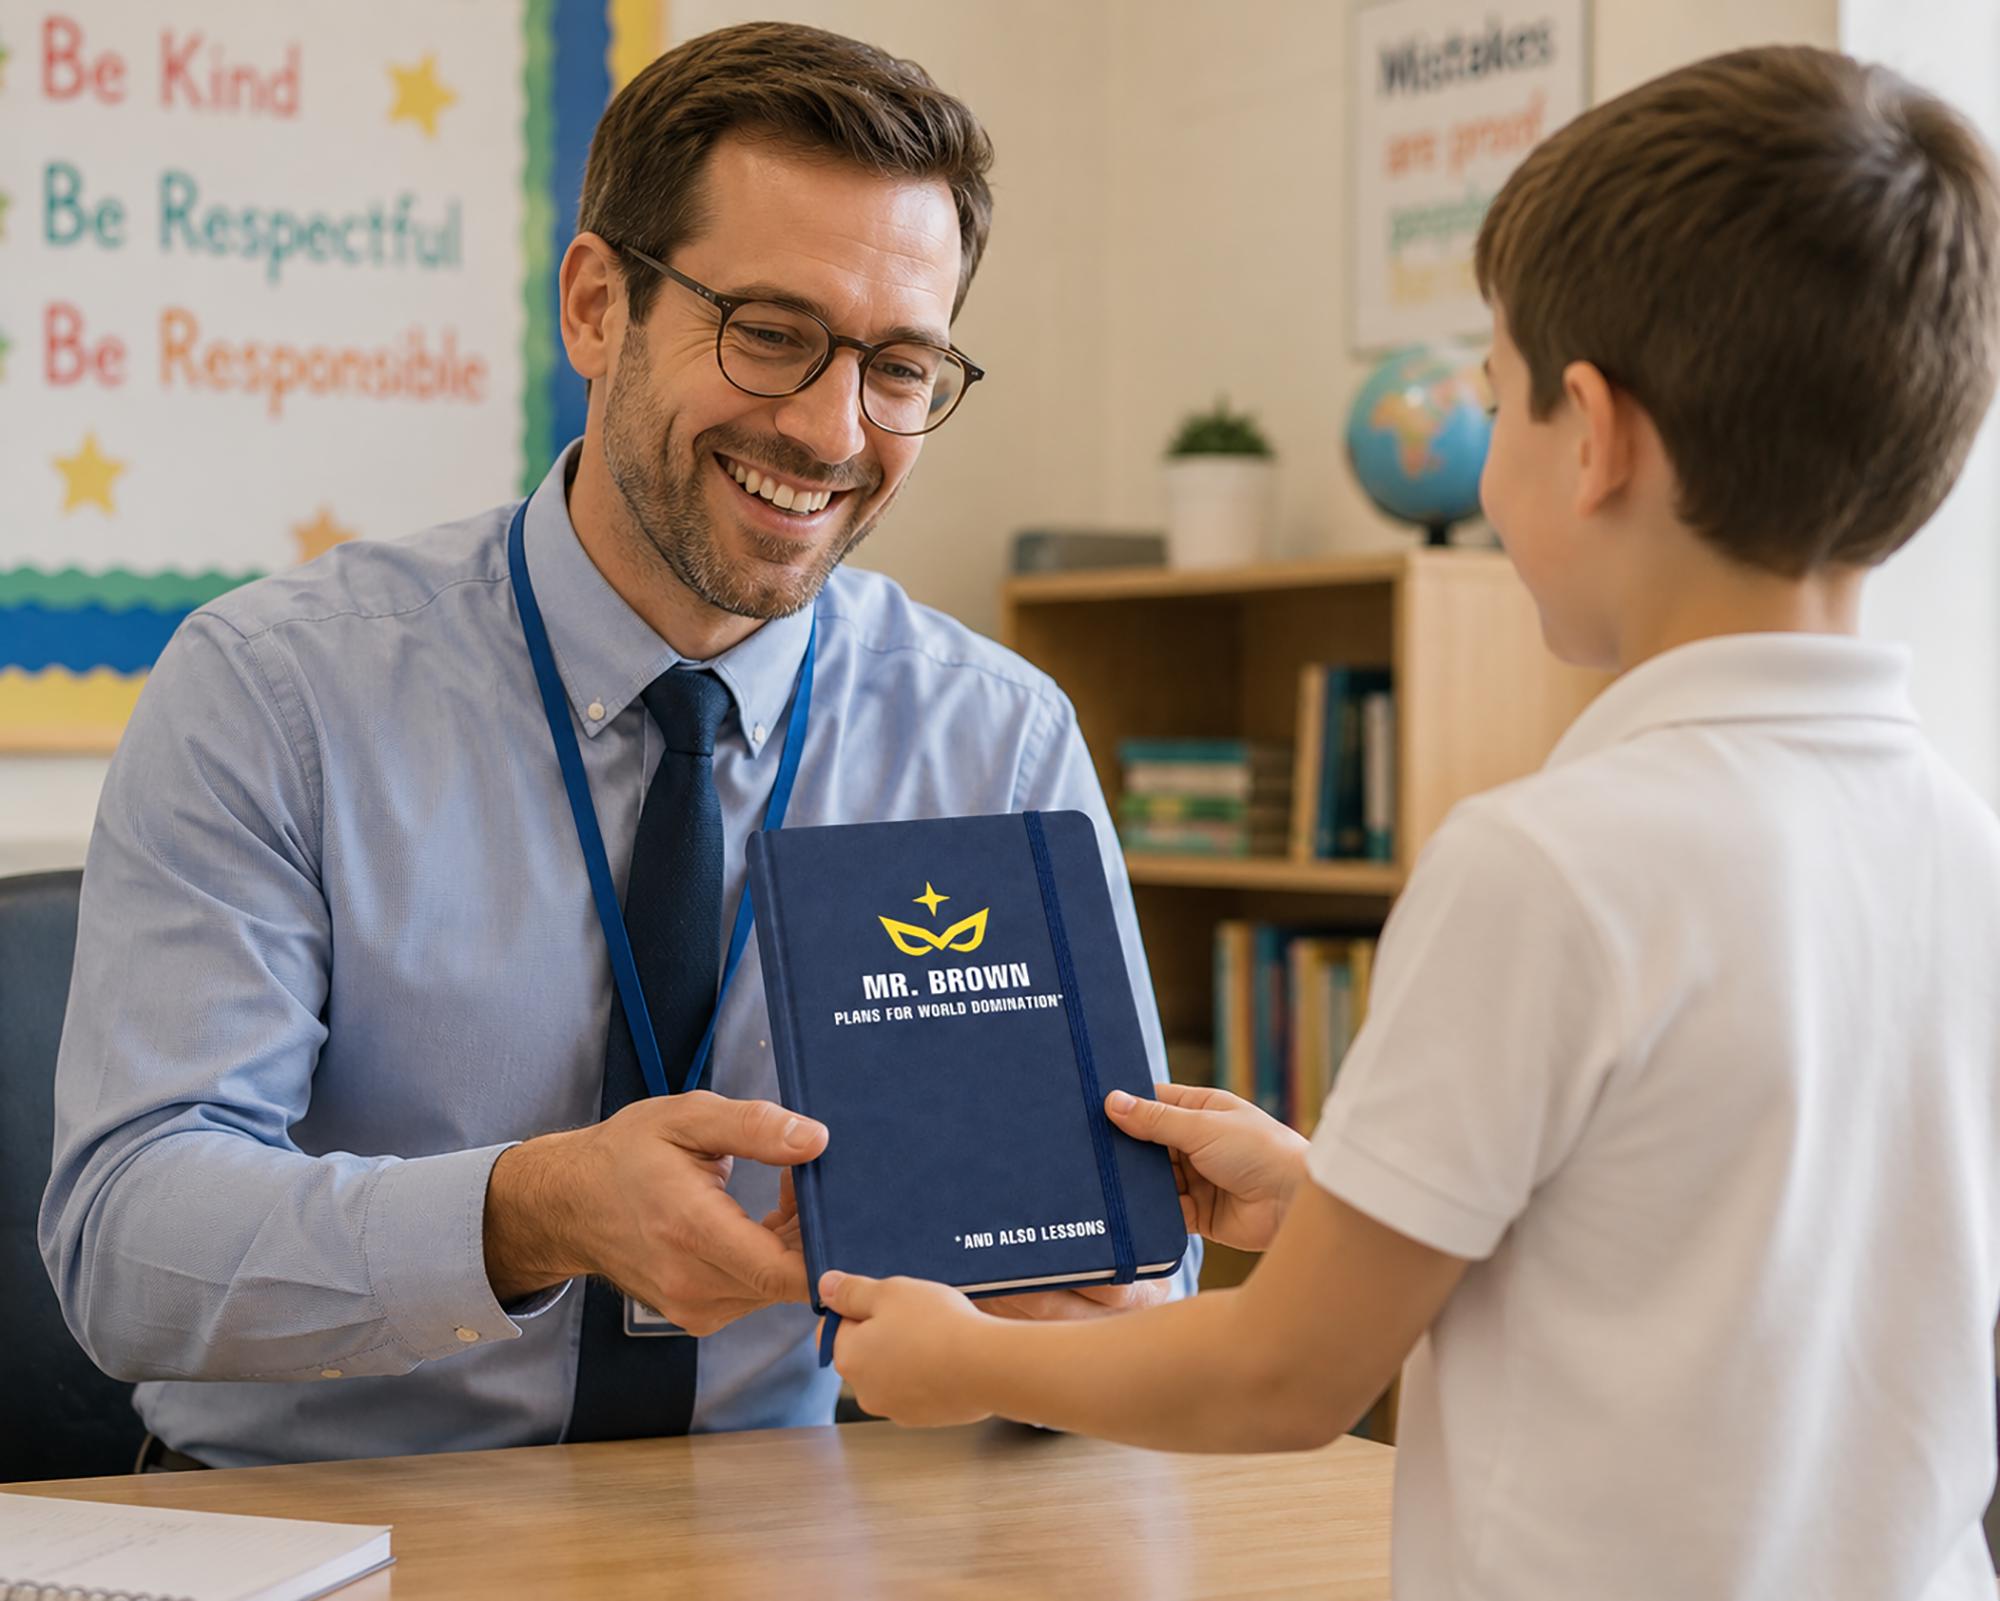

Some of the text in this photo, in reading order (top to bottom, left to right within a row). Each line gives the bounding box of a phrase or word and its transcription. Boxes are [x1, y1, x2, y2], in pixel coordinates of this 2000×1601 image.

[41, 15, 302, 119] Be Kind
[43, 161, 464, 285] Be Respectful
[43, 302, 488, 420] Be Responsible
[834, 1008, 881, 1026] PLANS
[885, 1005, 914, 1022] FOR
[917, 1000, 967, 1019] WORLD
[862, 962, 1031, 1000] MR. BROWN
[999, 1227, 1037, 1246] ALSO
[1040, 1219, 1106, 1241] LESSONS
